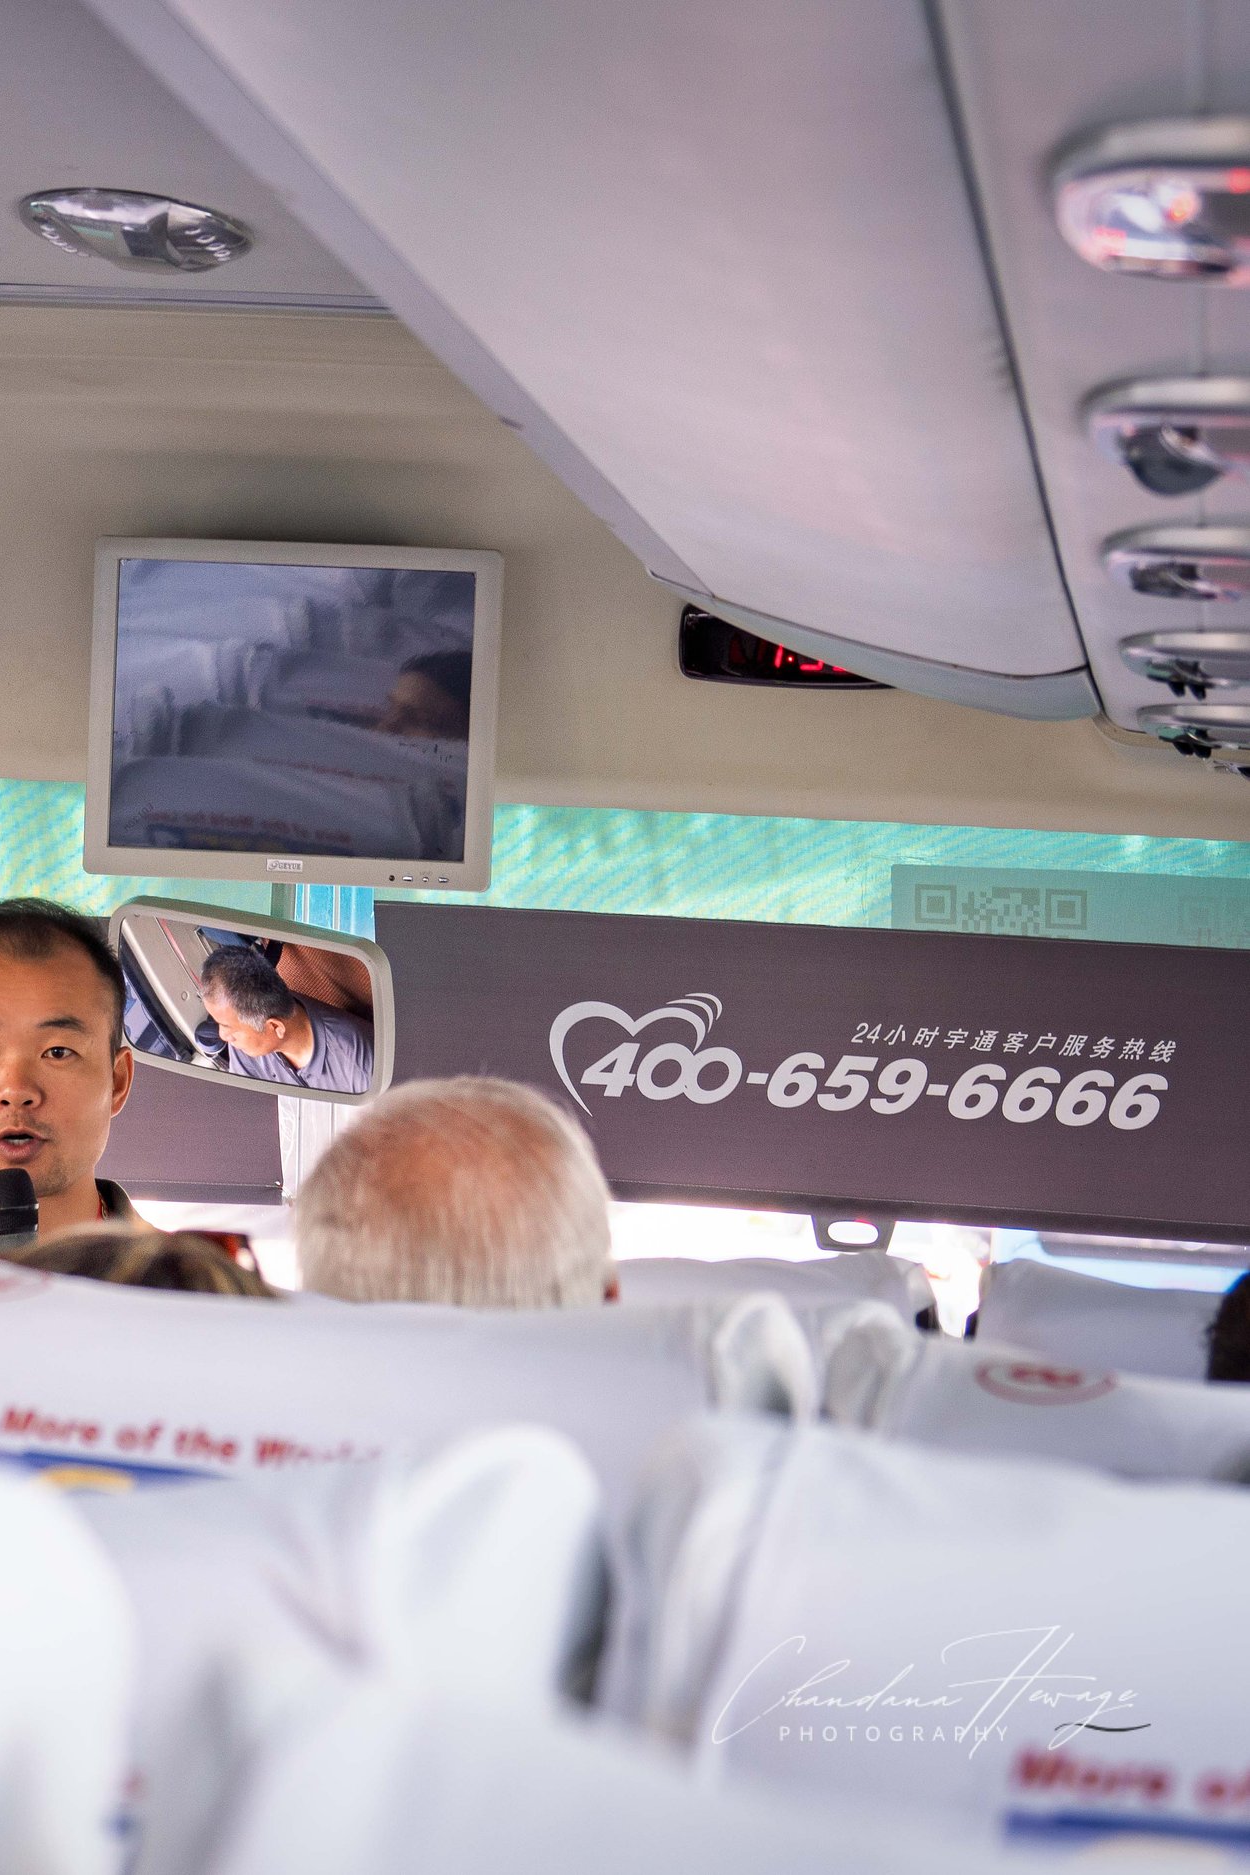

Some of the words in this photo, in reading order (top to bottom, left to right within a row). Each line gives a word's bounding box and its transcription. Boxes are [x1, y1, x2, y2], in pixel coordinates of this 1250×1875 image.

[850, 1021, 1177, 1064] 24小时宇通客户服务热线
[580, 1041, 1169, 1131] 400-659-6666
[115, 1410, 163, 1452] of
[174, 1418, 239, 1460] the
